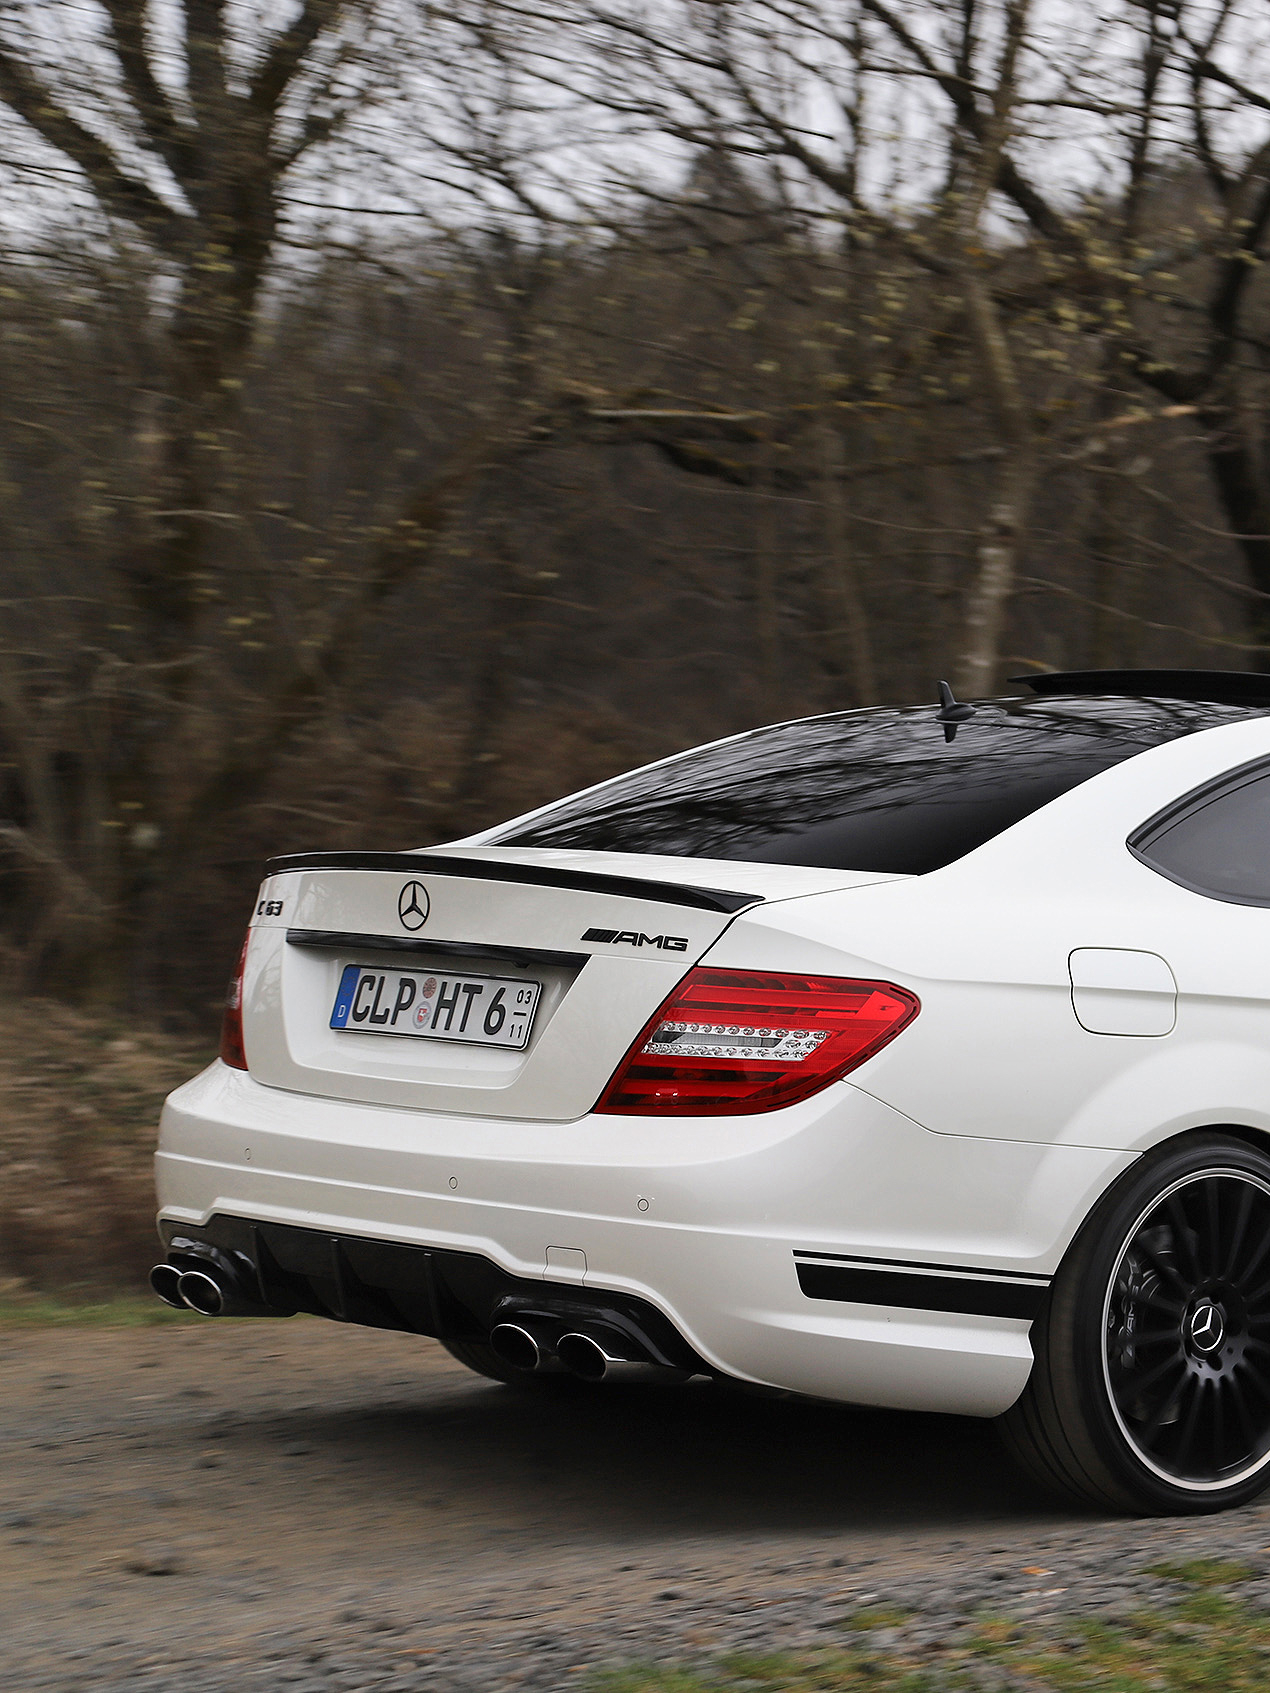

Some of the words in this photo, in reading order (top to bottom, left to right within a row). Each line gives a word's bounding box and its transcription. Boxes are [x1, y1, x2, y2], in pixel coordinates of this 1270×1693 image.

[257, 900, 266, 916] C
[266, 900, 283, 917] 63
[611, 930, 689, 952] AMG
[352, 974, 417, 1026] CLP
[430, 981, 484, 1033] HT
[483, 987, 507, 1036] 6
[516, 989, 533, 1005] 03
[337, 1004, 347, 1018] D
[509, 1023, 524, 1039] 11
